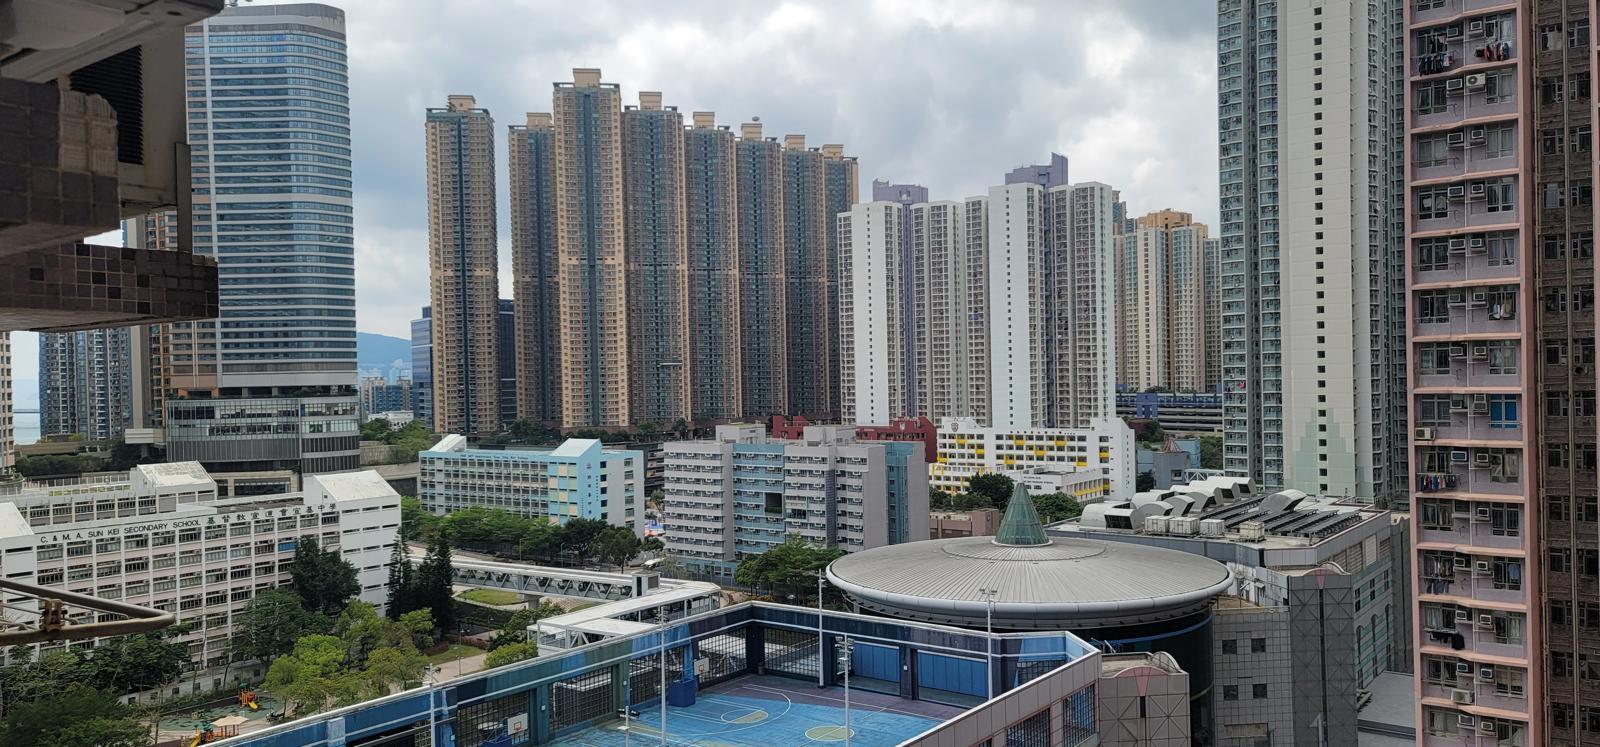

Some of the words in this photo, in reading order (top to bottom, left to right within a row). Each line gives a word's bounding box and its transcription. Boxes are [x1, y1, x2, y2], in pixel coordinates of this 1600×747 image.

[206, 503, 337, 525] 基督教宣道會宣基中學
[87, 530, 104, 538] SUN
[107, 528, 120, 536] KEI
[124, 523, 168, 534] SECONDARY
[172, 519, 201, 528] SCHOOL
